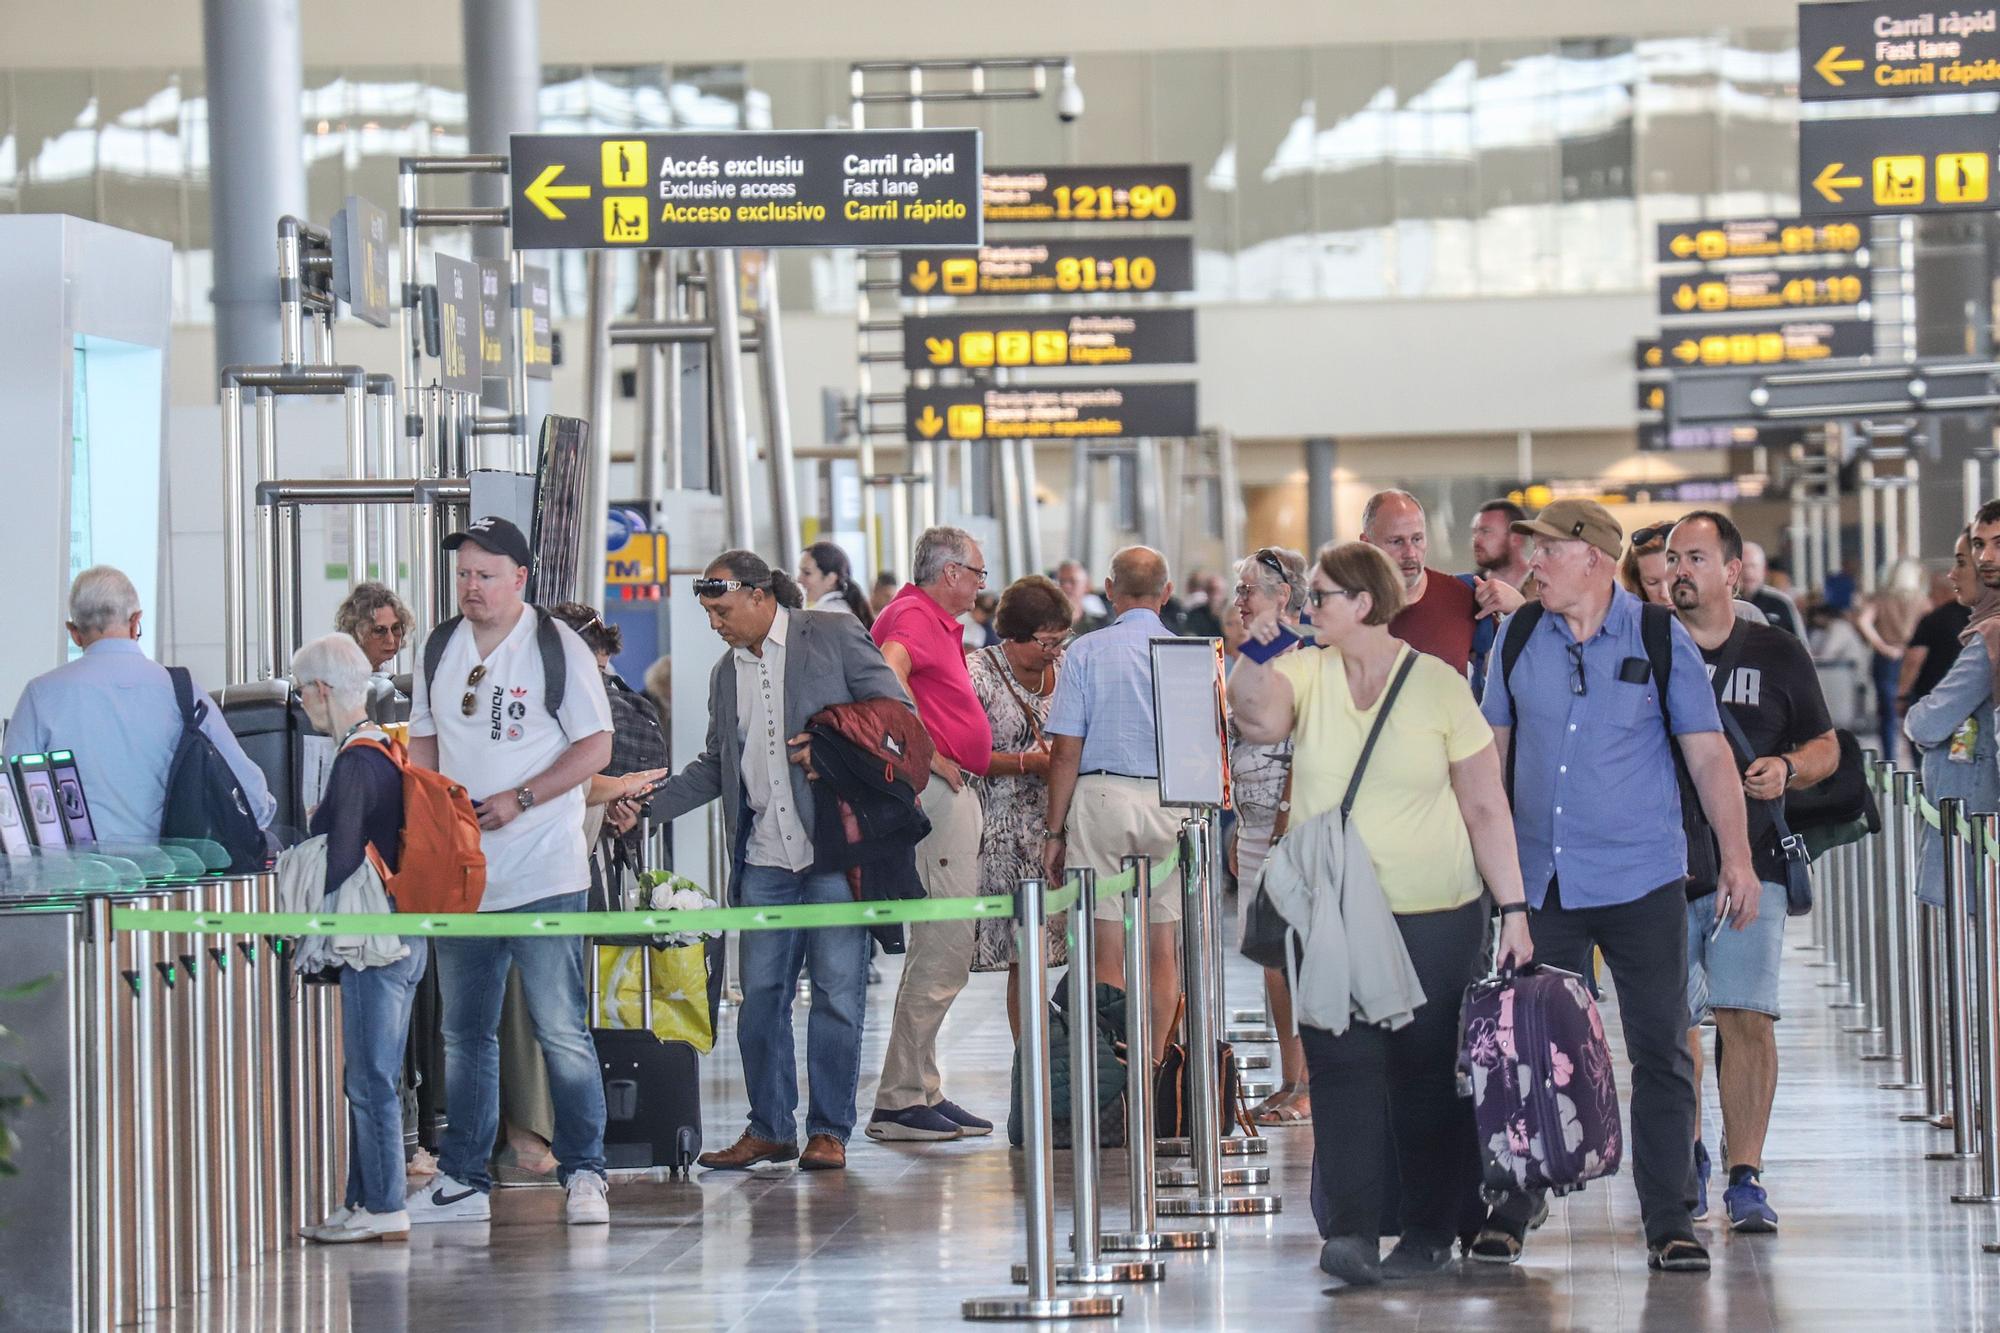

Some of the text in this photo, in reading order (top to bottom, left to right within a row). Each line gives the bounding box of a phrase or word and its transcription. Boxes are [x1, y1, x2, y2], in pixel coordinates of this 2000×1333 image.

[1874, 14, 1934, 38] Carril
[1875, 39, 1961, 61] Fast lane
[1874, 63, 1935, 87] Carril
[724, 155, 804, 177] exclusiu
[843, 153, 955, 177] Carril ràpid
[660, 180, 796, 199] Exclusive access
[843, 178, 919, 197] Fast lane
[661, 201, 826, 222] Acceso exclusivo
[844, 199, 967, 223] Carril rápido
[491, 685, 504, 741] ADIDAS
